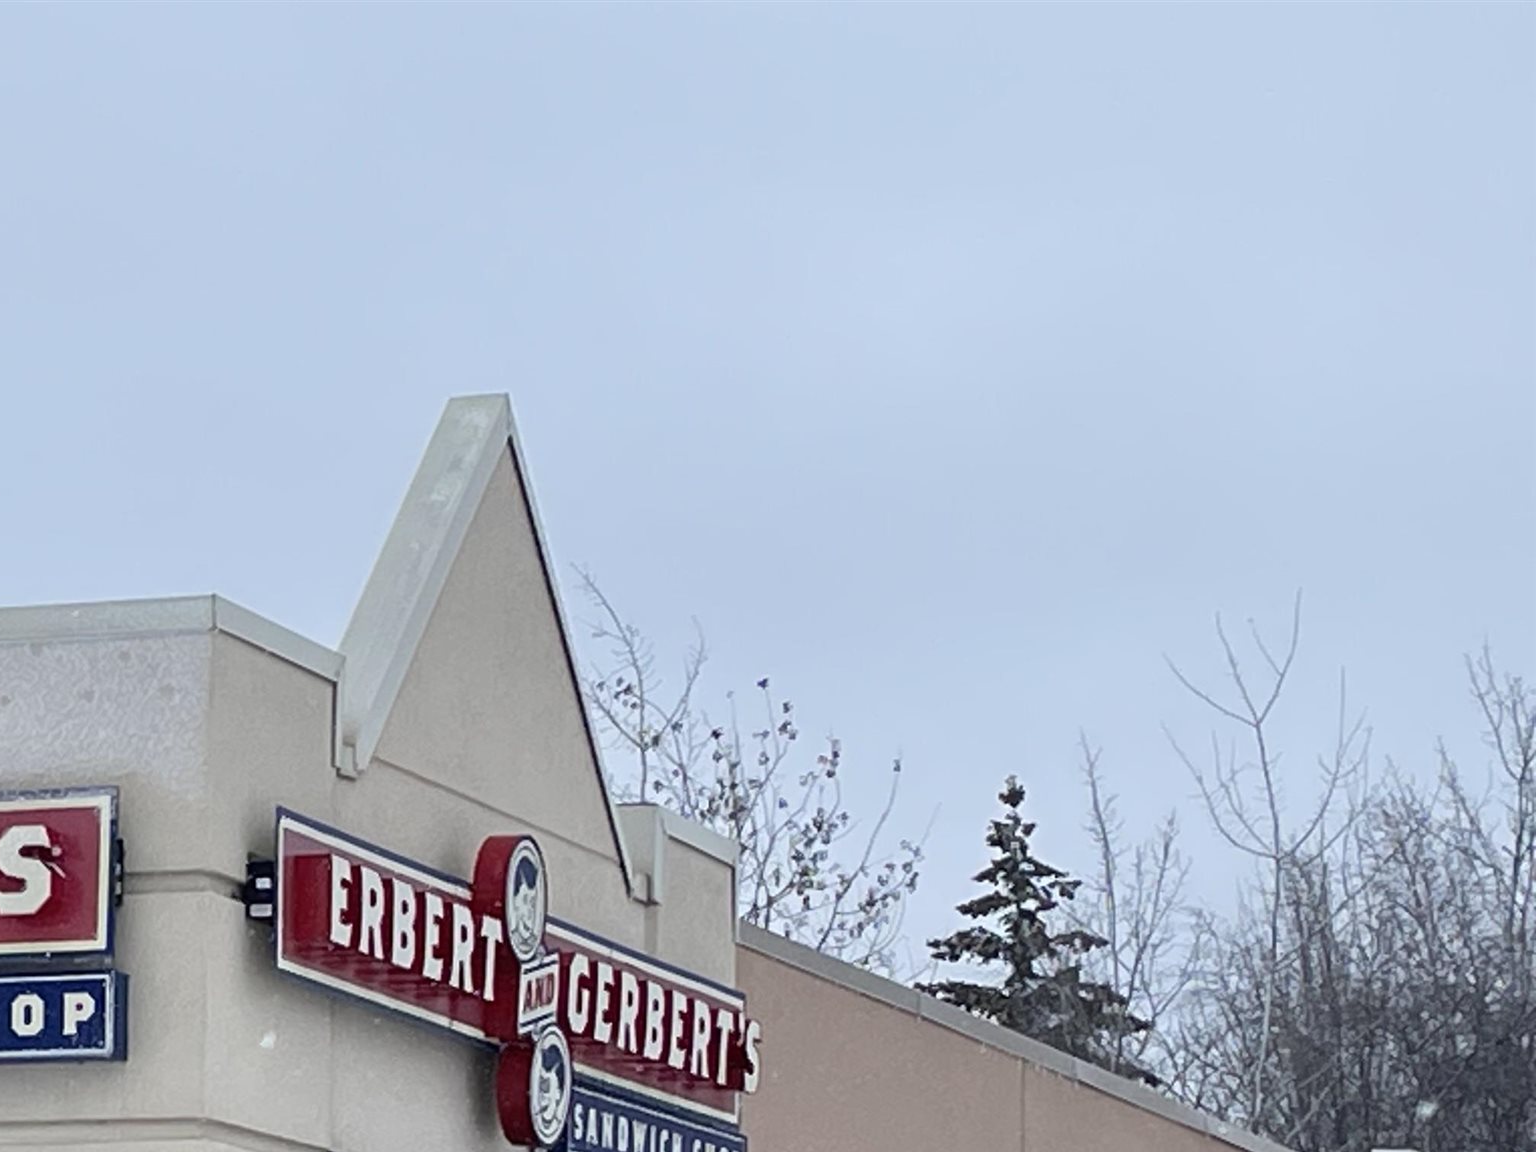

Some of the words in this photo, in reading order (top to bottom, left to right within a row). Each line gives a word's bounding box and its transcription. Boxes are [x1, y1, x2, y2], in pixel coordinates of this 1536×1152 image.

[329, 853, 503, 1002] ERBERT
[522, 972, 556, 1015] AND
[567, 951, 763, 1095] GERBERT'S
